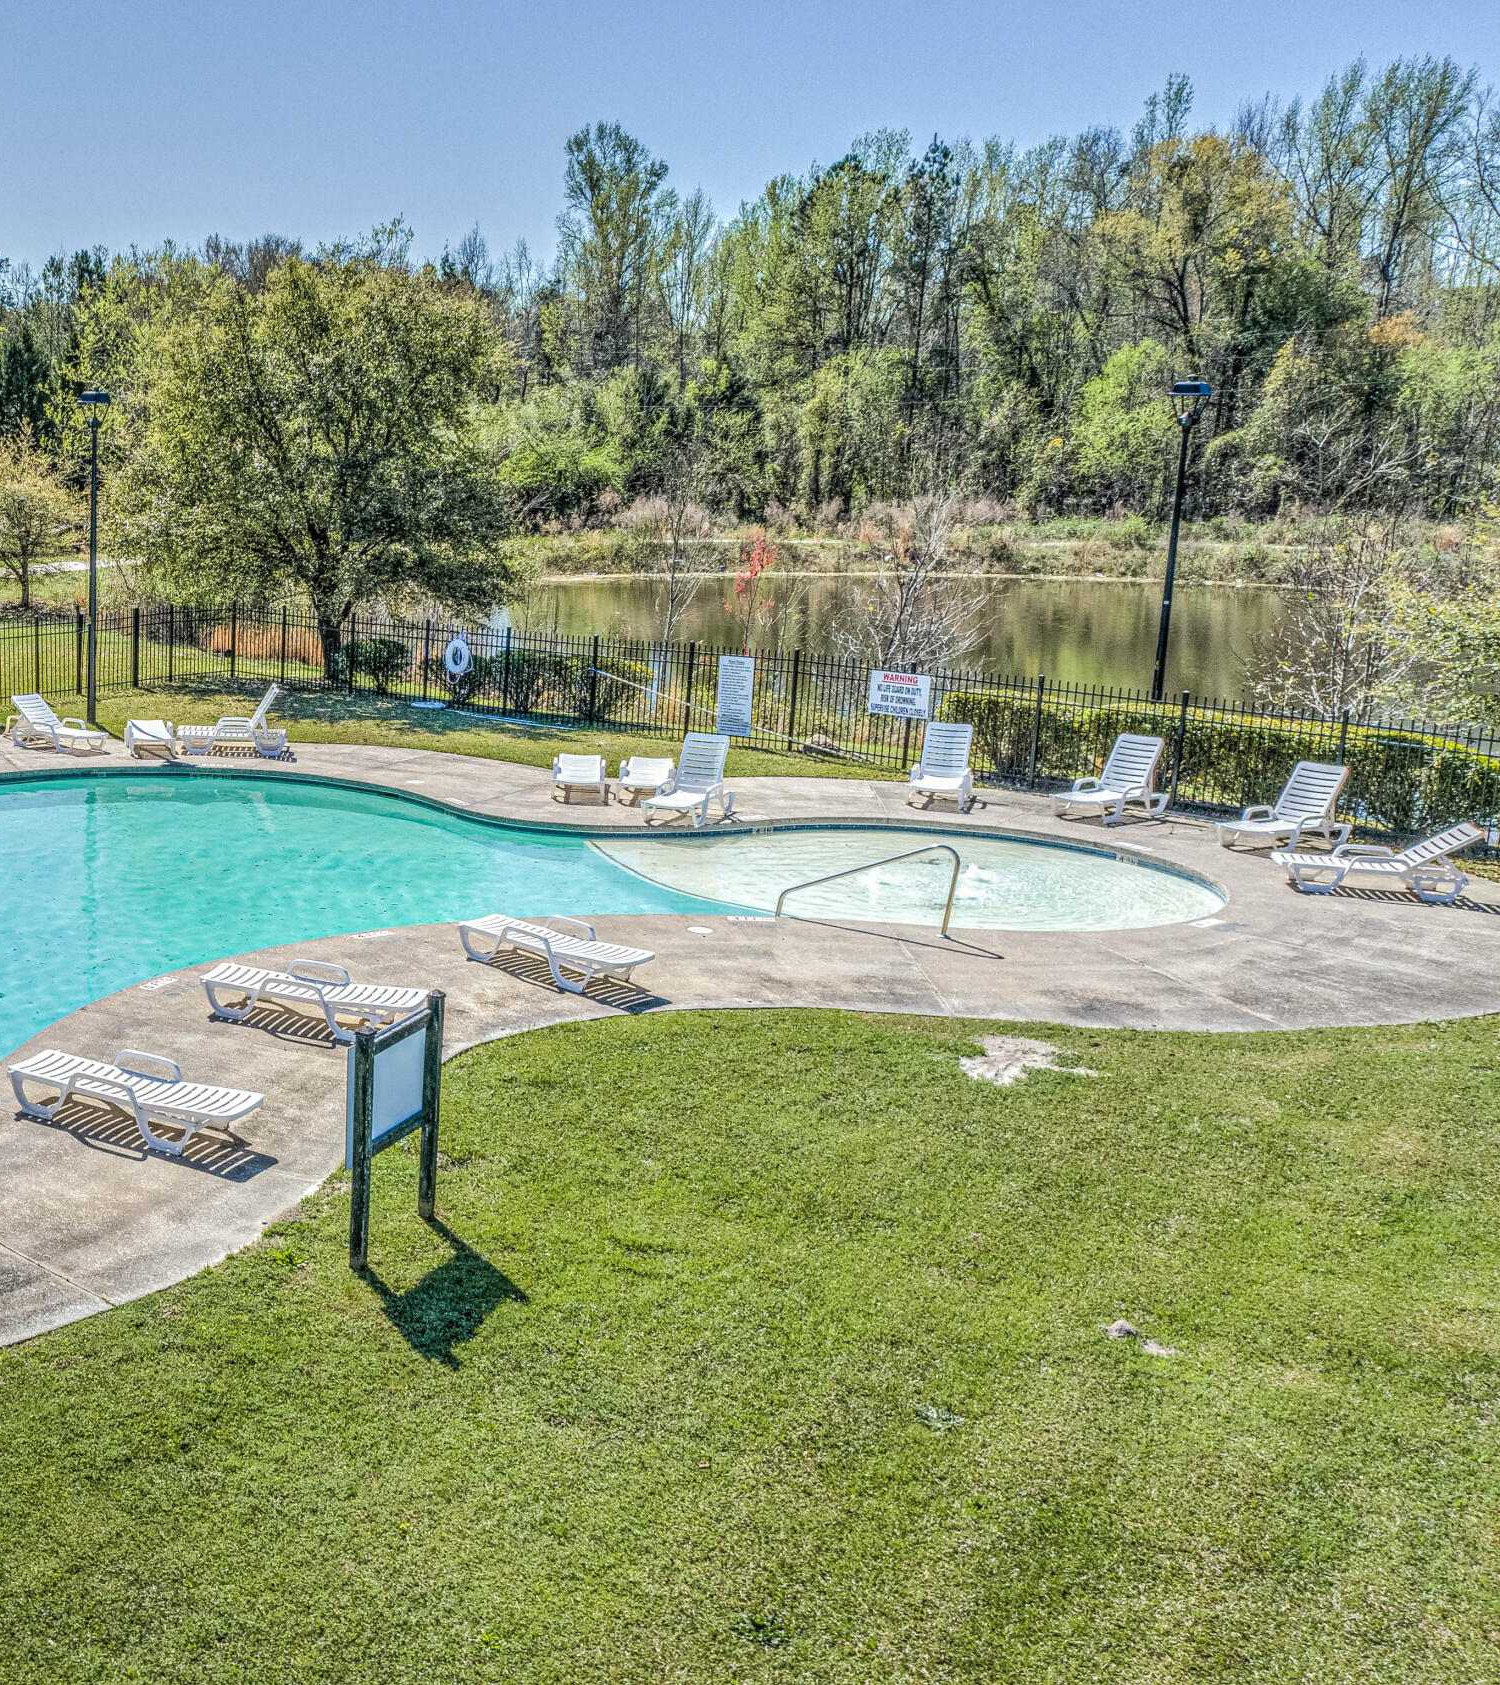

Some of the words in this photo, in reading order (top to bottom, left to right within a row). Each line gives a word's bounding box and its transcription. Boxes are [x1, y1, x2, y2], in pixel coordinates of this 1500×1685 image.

[884, 673, 918, 684] WARNING
[883, 684, 891, 693] LIFE
[891, 685, 904, 694] GUARD
[905, 686, 910, 695] ON
[881, 694, 889, 703] RISK
[890, 695, 895, 703] OF
[871, 703, 890, 713] SUPERVISE
[890, 704, 908, 715] CHILDREN
